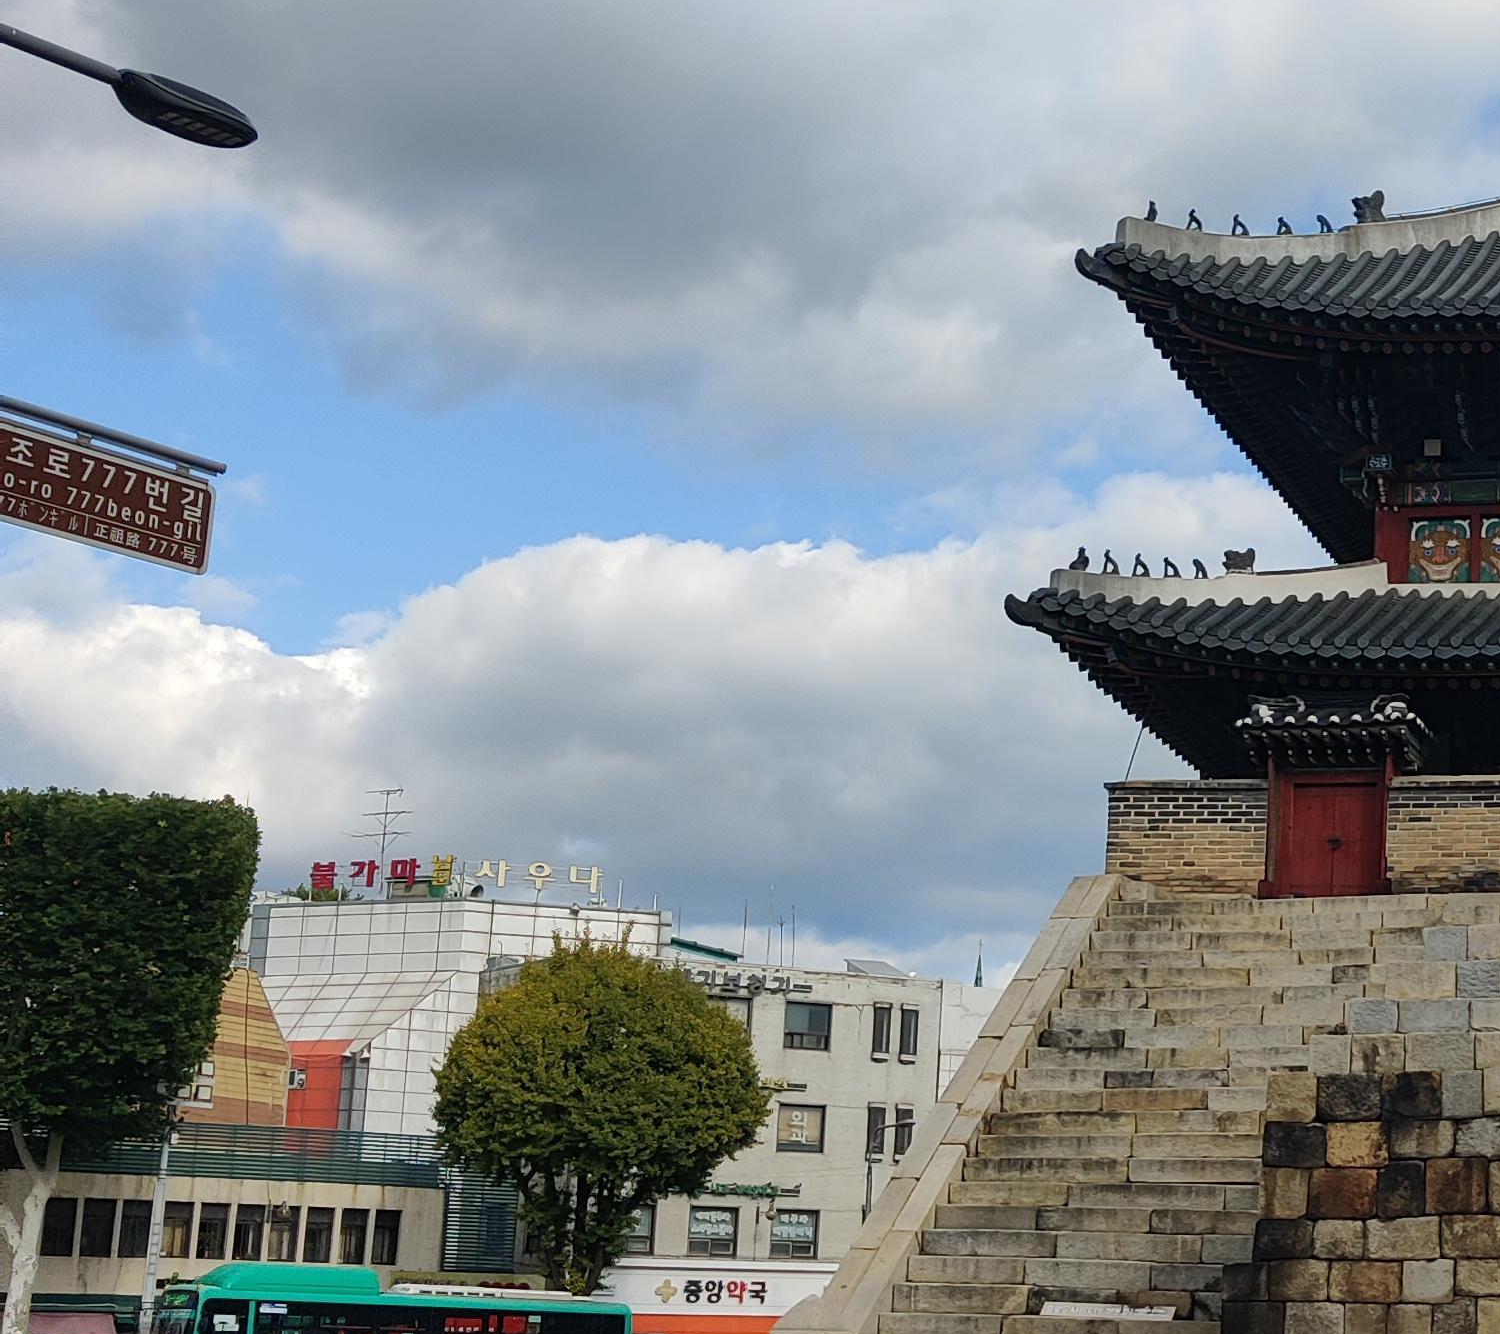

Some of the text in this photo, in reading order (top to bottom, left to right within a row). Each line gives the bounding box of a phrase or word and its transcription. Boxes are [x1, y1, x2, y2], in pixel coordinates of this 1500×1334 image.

[66, 486, 202, 542] 777beon-gil
[310, 858, 421, 890] 불가마
[476, 859, 603, 894] 사우나
[684, 969, 791, 999] 기보청기
[683, 1280, 768, 1304] 중앙약국
